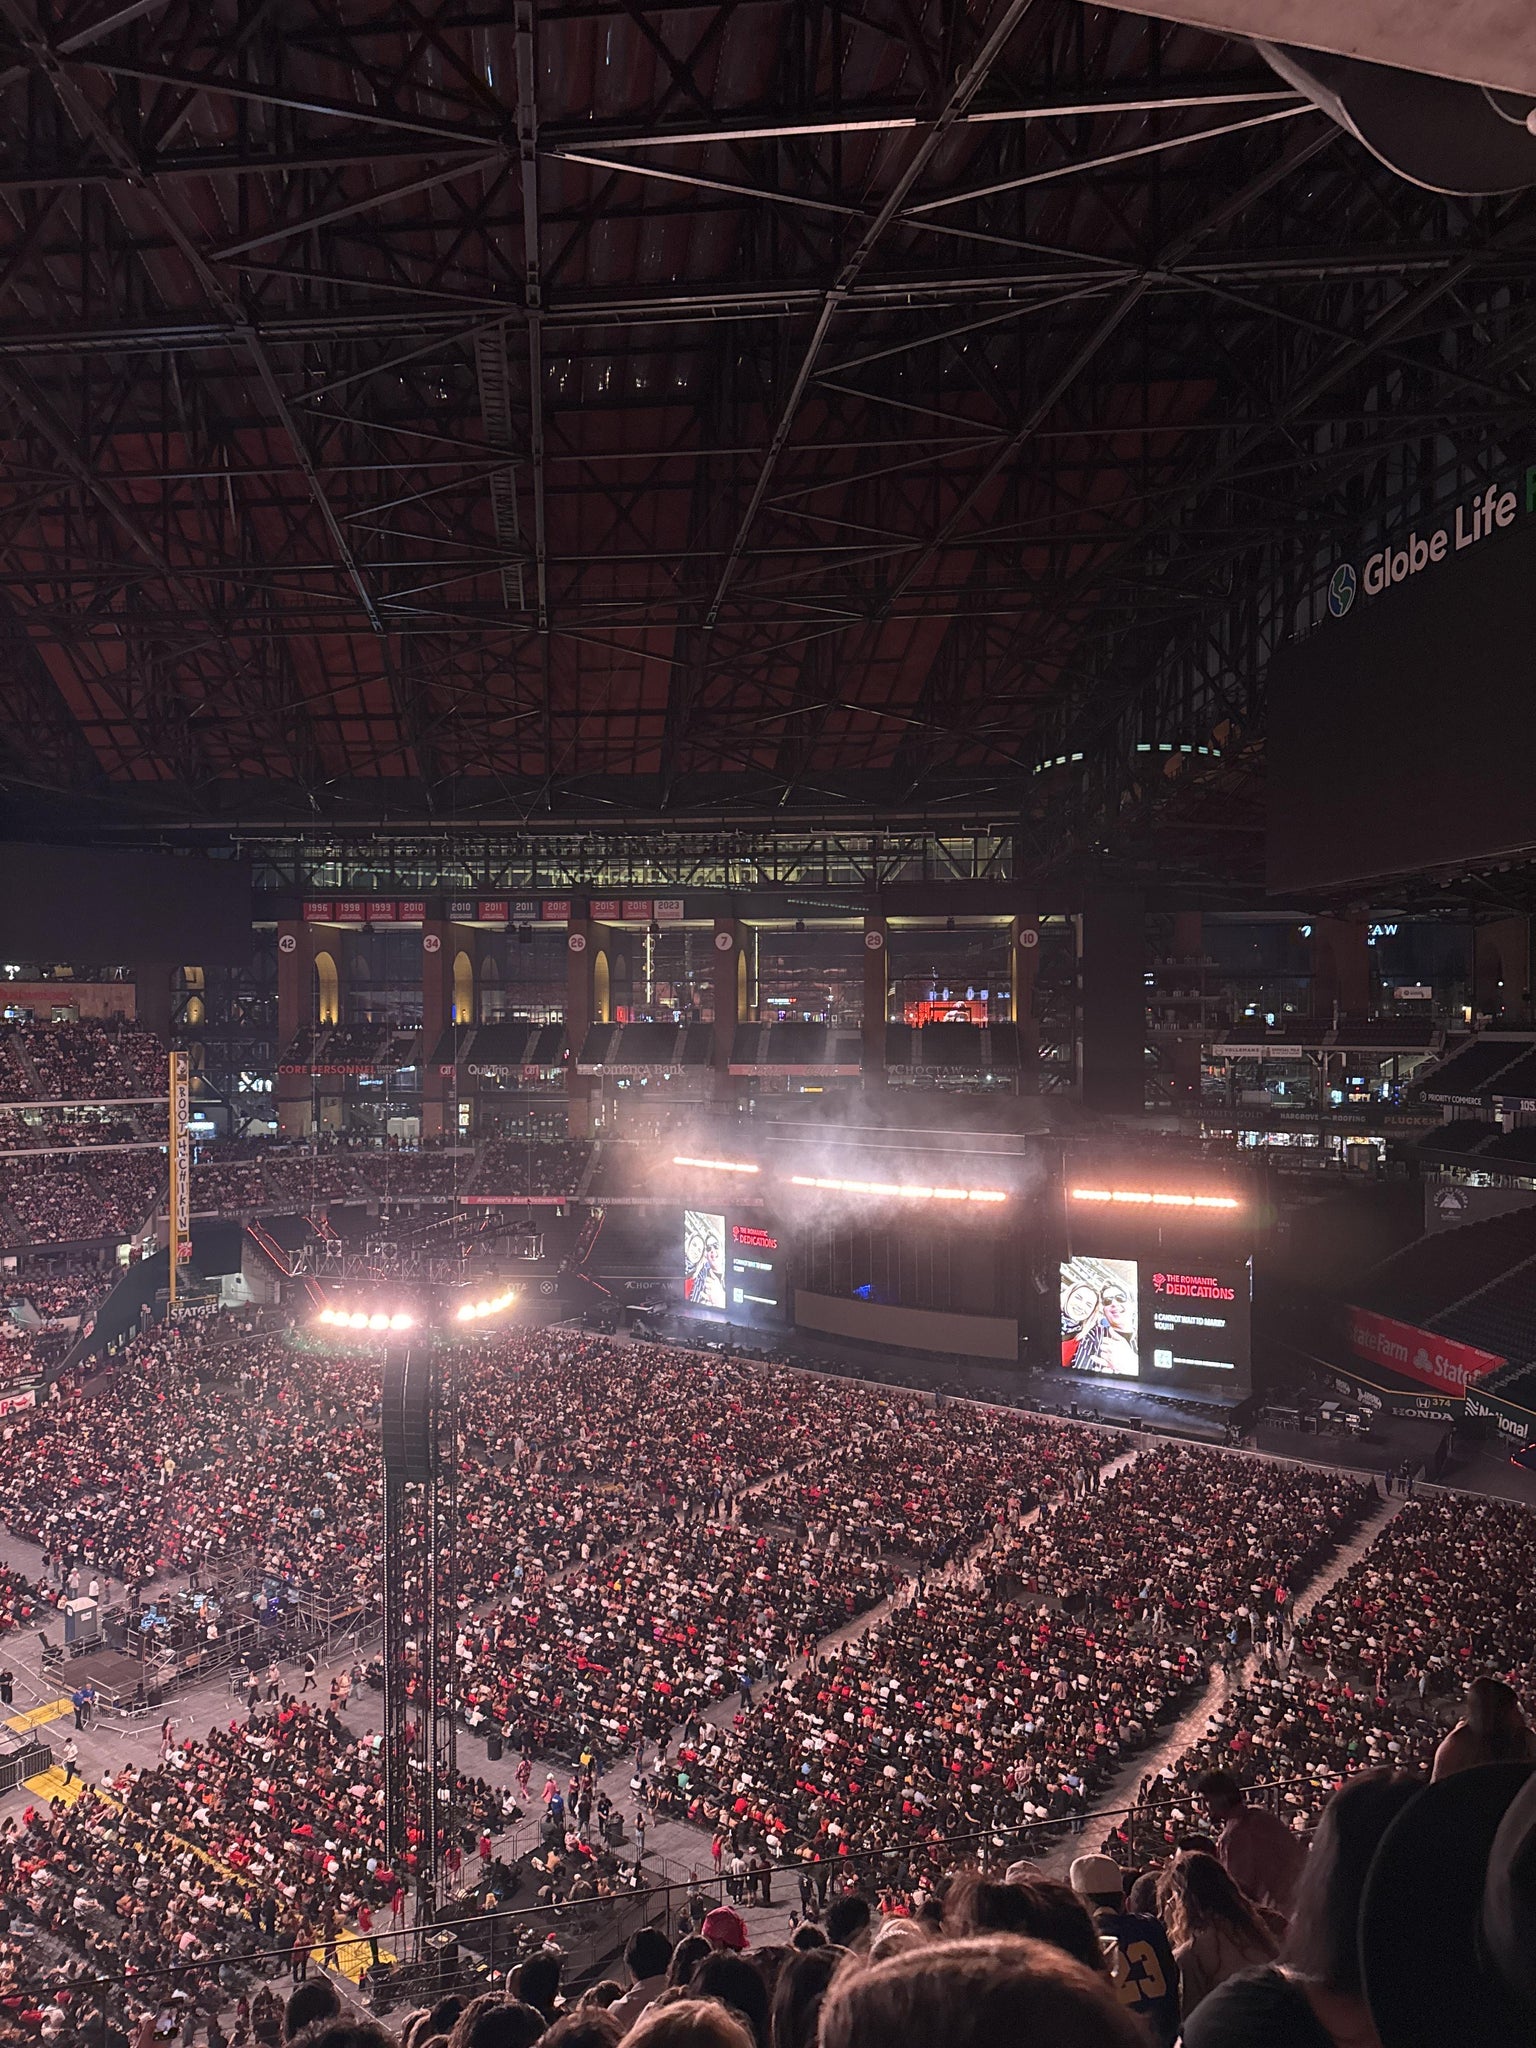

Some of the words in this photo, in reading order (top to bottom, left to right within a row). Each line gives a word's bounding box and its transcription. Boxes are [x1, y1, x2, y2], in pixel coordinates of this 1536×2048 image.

[1363, 529, 1448, 595] Globe
[1455, 483, 1517, 551] Life
[308, 903, 328, 912] 1996
[340, 903, 360, 912] 1998
[403, 903, 424, 911] 2010
[451, 902, 471, 911] 2010
[484, 902, 502, 911] 2011
[515, 902, 533, 911] 2011
[547, 902, 567, 911] 2012
[595, 901, 615, 910] 2015
[627, 901, 647, 910] 2016
[657, 901, 680, 910] 2023
[425, 938, 439, 948] 34
[570, 937, 584, 948] 26
[721, 937, 728, 947] 7
[867, 935, 881, 945] 29
[1023, 933, 1034, 944] 10
[281, 939, 294, 949] 42
[279, 1065, 308, 1074] CORE
[311, 1065, 376, 1074] PERSONNEL
[468, 1064, 509, 1076] QuikTrip
[654, 1064, 686, 1075] Bank
[895, 1064, 962, 1075] CHOCTAW
[1428, 1094, 1450, 1102] PRIORITY
[1451, 1095, 1482, 1105] COMMERCE
[1332, 1114, 1366, 1122] ROOFING
[740, 1234, 777, 1248] DEDICATIONS
[1166, 1274, 1180, 1282] THE
[1180, 1275, 1218, 1286] ROMANTIC
[1166, 1283, 1235, 1300] DEDICATIONS
[1432, 1399, 1451, 1407] 374
[1392, 1407, 1455, 1421] HONDA
[1478, 1405, 1528, 1439] Nional
